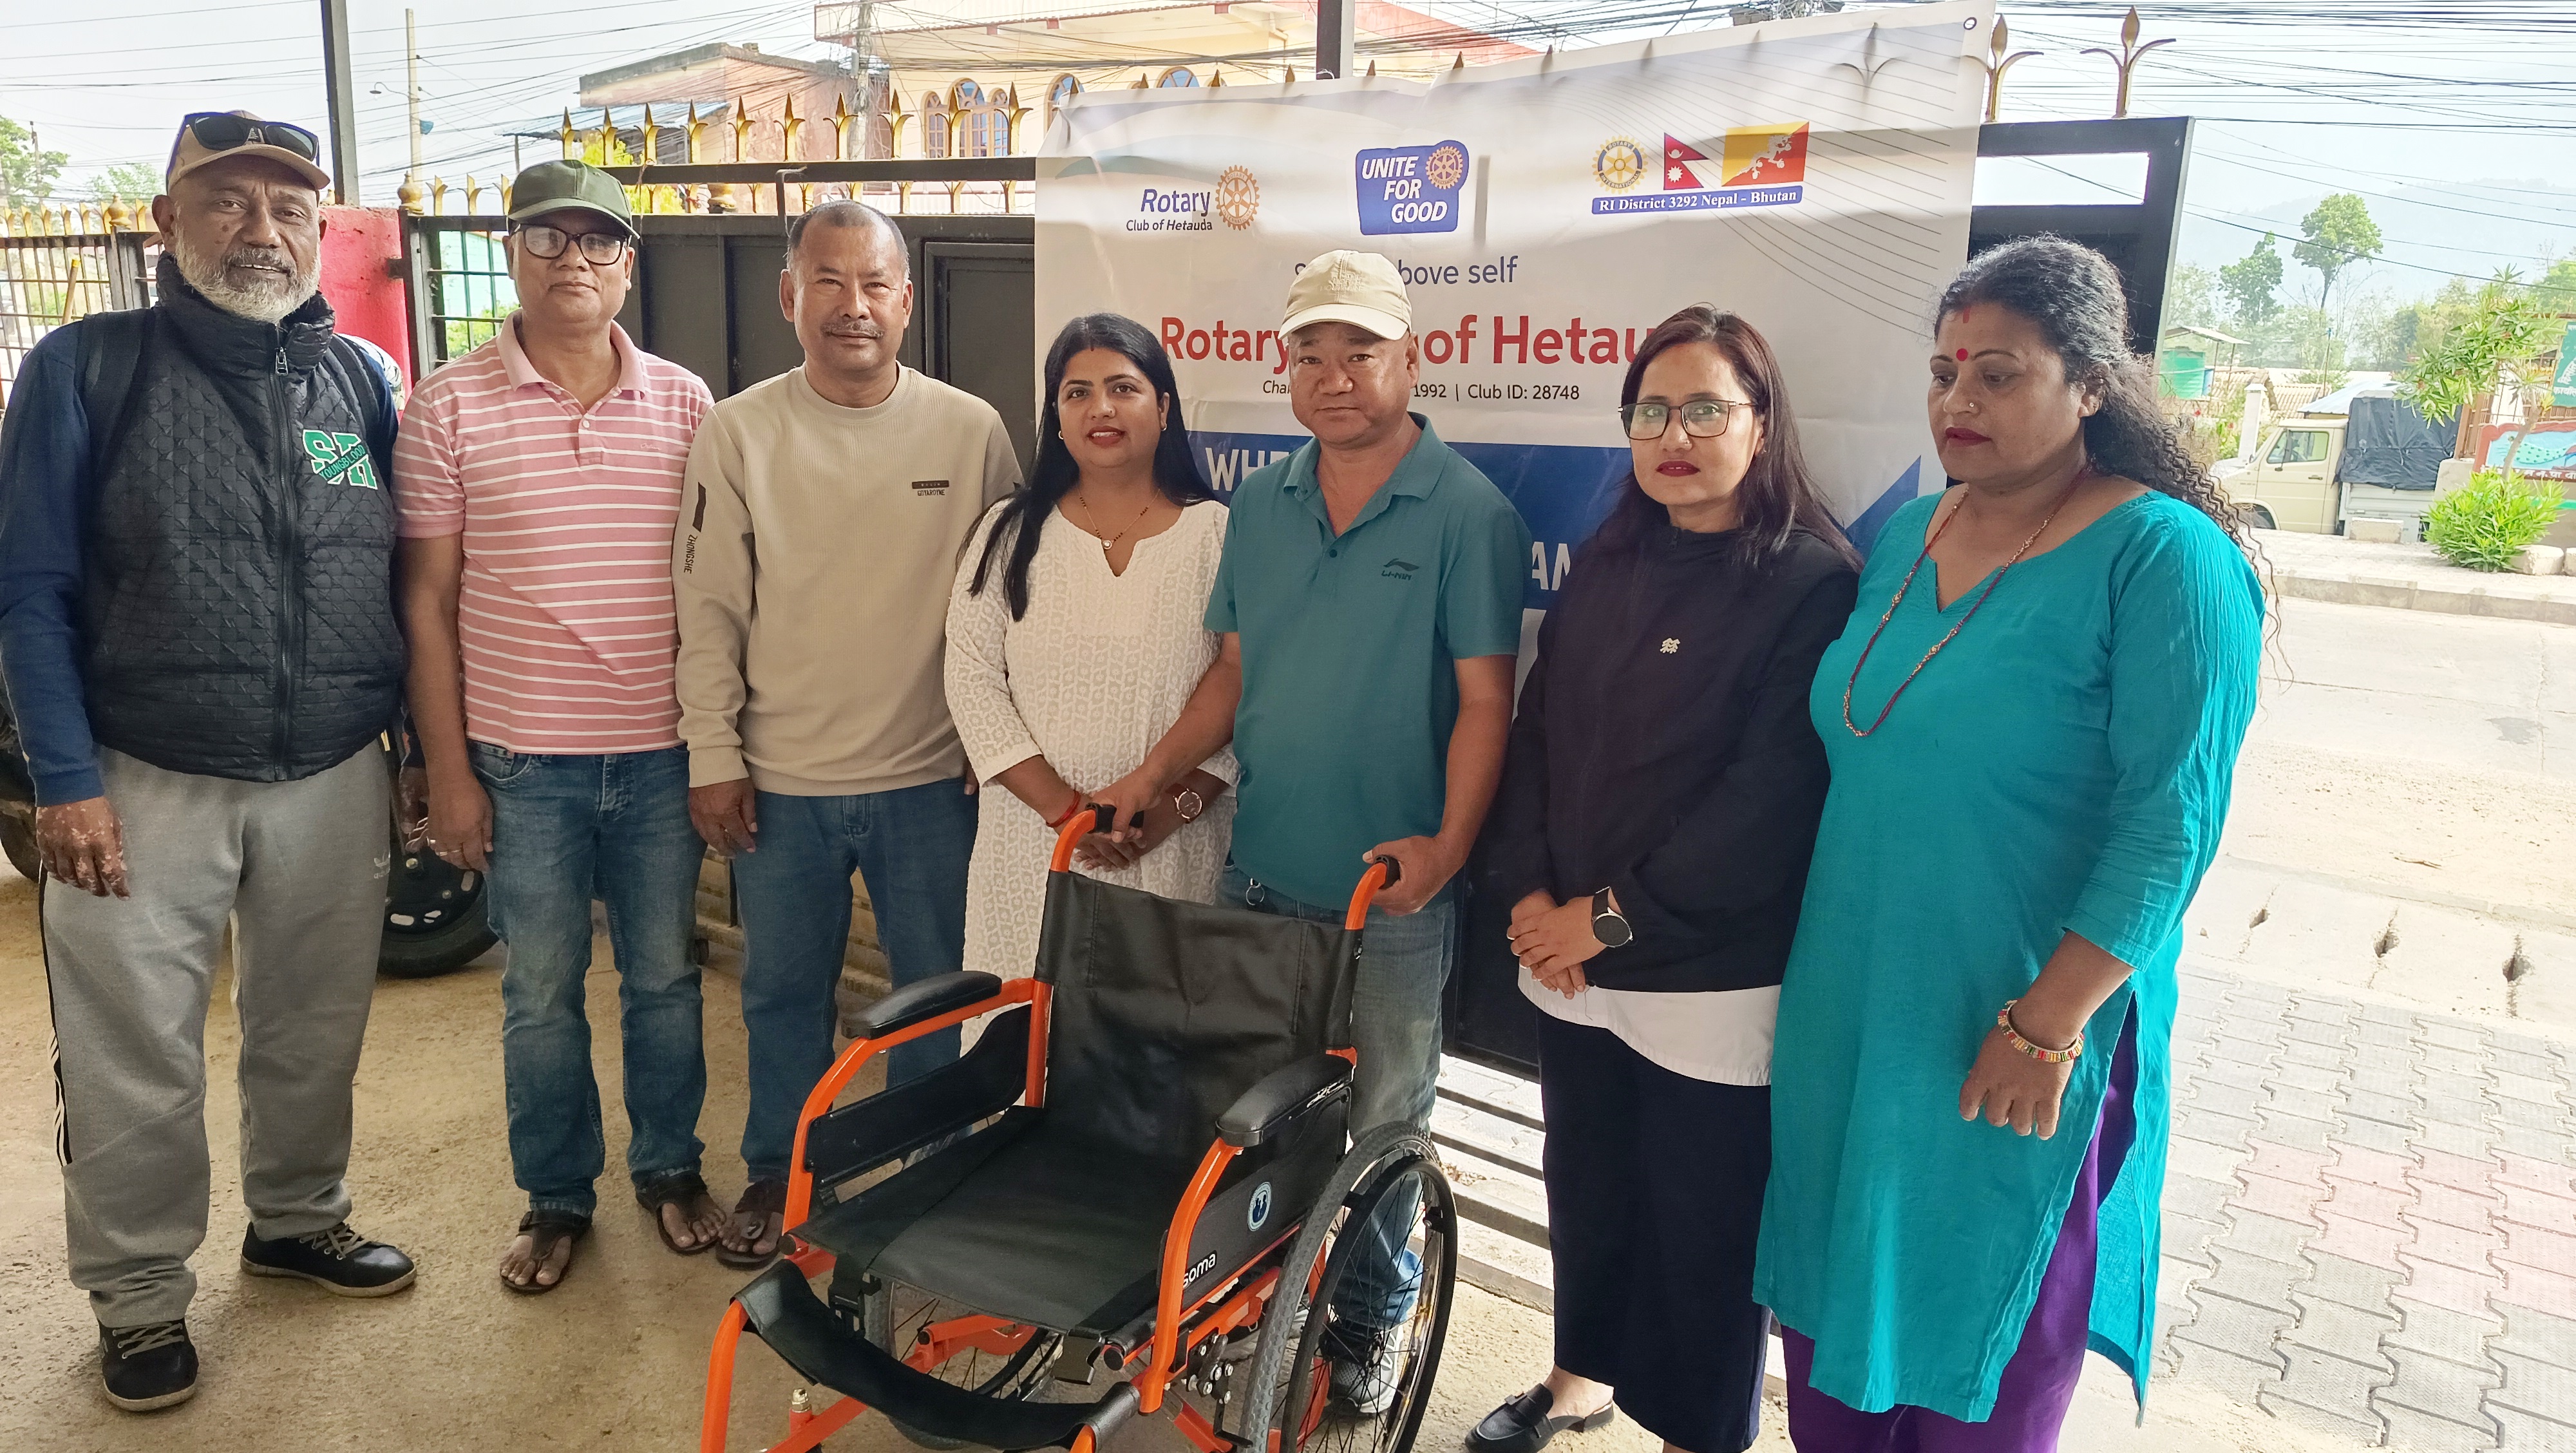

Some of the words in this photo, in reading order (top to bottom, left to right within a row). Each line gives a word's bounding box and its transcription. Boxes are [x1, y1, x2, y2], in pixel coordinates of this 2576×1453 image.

[1362, 157, 1419, 179] UNITE
[1384, 179, 1422, 200] FOR
[1141, 189, 1210, 216] Rotary
[1392, 201, 1448, 223] GOOD
[1599, 200, 1615, 211] RI
[1619, 197, 1665, 209] District
[1669, 196, 1697, 207] 3292
[1701, 193, 1738, 208] Nepal
[1750, 191, 1796, 204] Bhutan
[1126, 220, 1150, 231] Club
[1152, 219, 1165, 231] of
[1166, 219, 1212, 231] Hetauda
[1398, 259, 1459, 285] bove
[1468, 256, 1519, 283] self
[1162, 317, 1289, 375] Rotary
[1424, 314, 1477, 365] of
[1493, 315, 1655, 365] Hetau
[1414, 385, 1447, 398] 1992
[1468, 385, 1502, 399] Club
[1508, 385, 1528, 399] ID:
[1533, 386, 1580, 399] 28748
[319, 445, 365, 480] YOUNGBLOOD
[683, 534, 698, 574] ZHONGSHE
